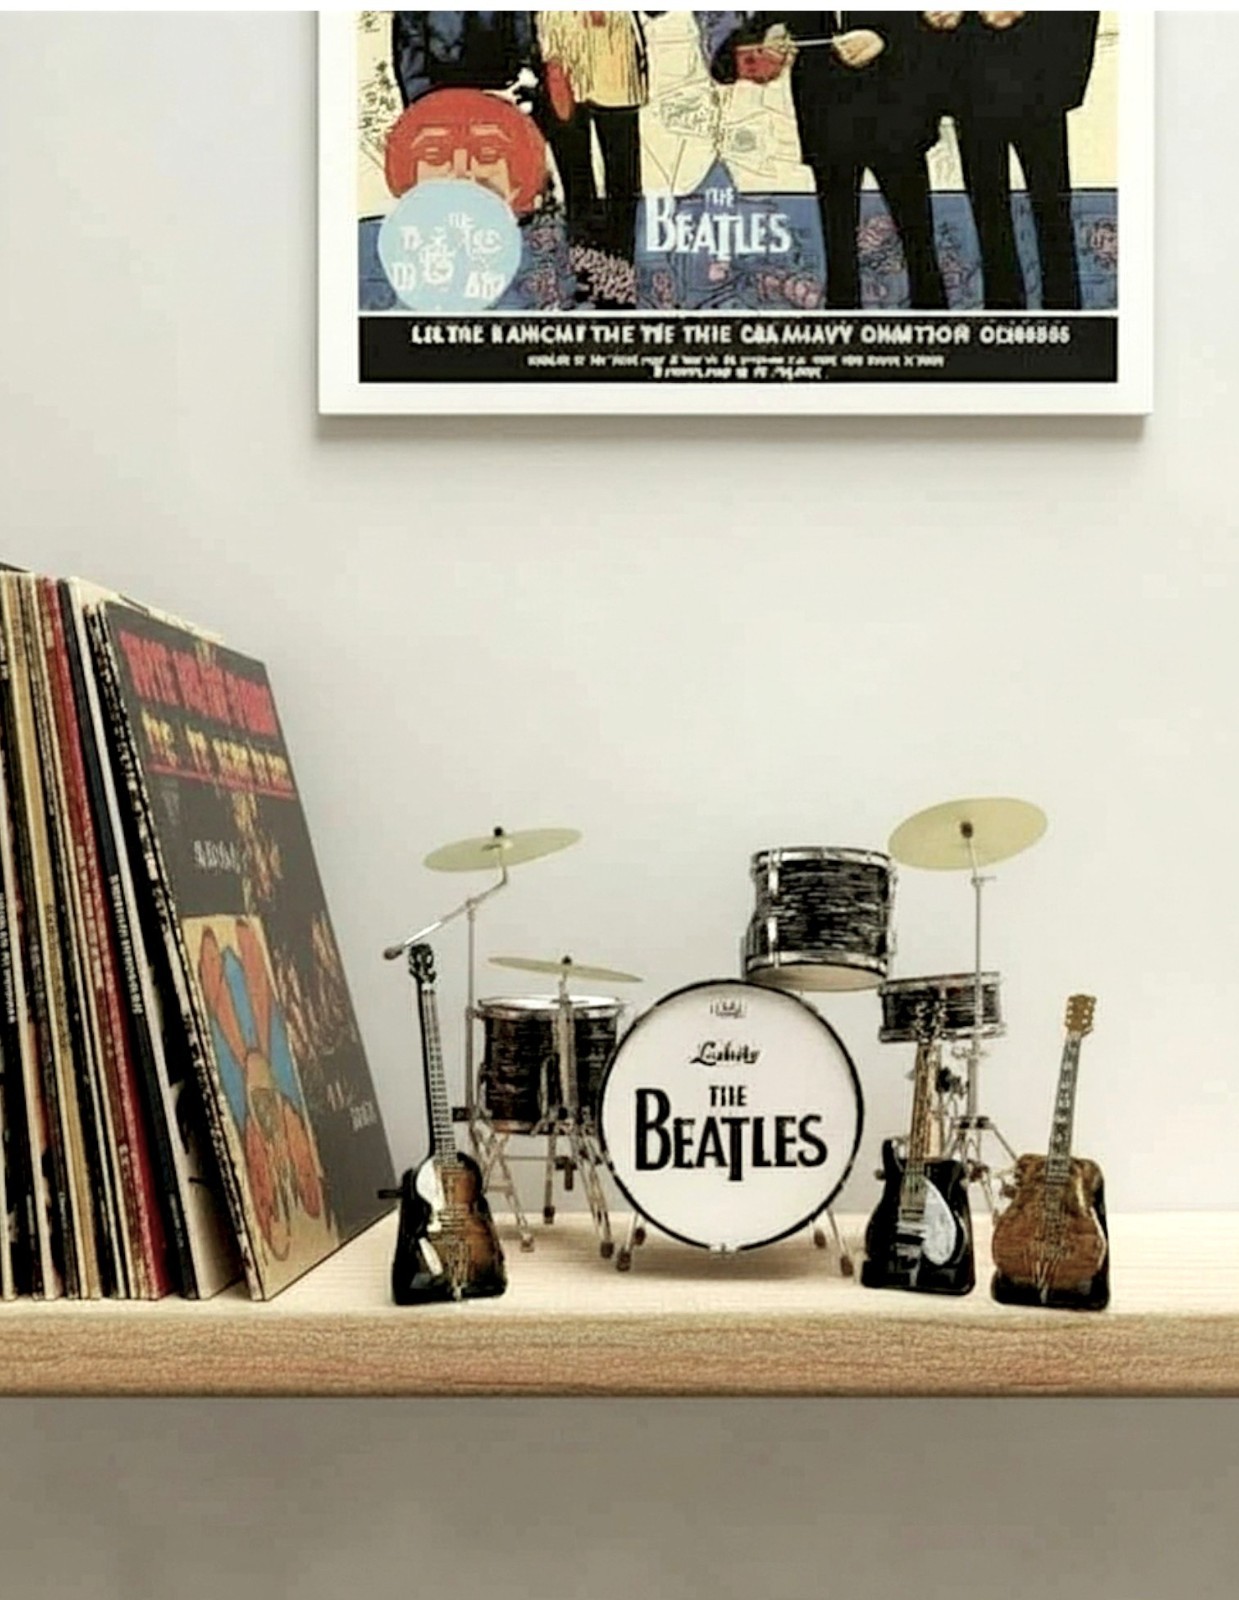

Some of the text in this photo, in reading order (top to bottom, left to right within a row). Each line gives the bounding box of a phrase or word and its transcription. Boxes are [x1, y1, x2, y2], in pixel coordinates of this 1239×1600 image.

[645, 193, 793, 261] BEATLES
[705, 187, 735, 207] THE
[635, 1088, 828, 1181] BEATLES
